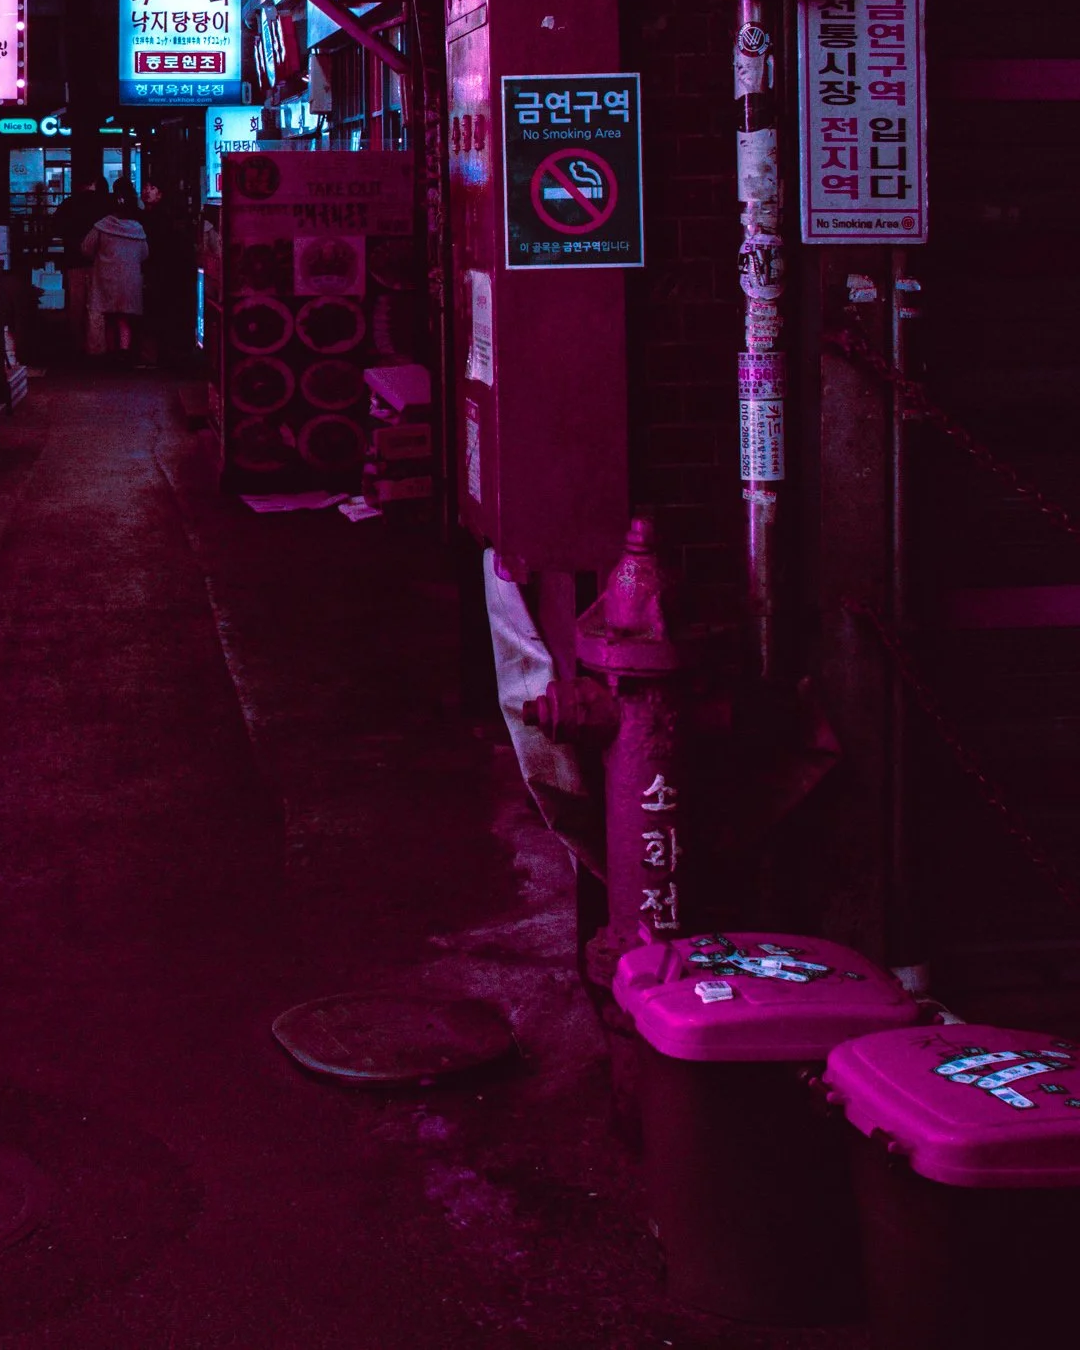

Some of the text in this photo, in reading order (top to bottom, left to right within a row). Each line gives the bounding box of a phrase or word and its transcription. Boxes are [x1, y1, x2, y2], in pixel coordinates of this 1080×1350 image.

[131, 10, 229, 34] 낙지탕탕이
[145, 55, 216, 70] 종로원조
[514, 89, 630, 125] 금연구역
[3, 122, 33, 131] Nice to
[523, 127, 622, 141] No Smoking Area
[820, 117, 859, 201] 전지역
[868, 117, 913, 200] 입니다
[816, 217, 899, 231] No Smoking Area
[520, 242, 529, 253] 이
[563, 240, 630, 253] 금연구역입니다
[640, 773, 681, 930] 소화전
